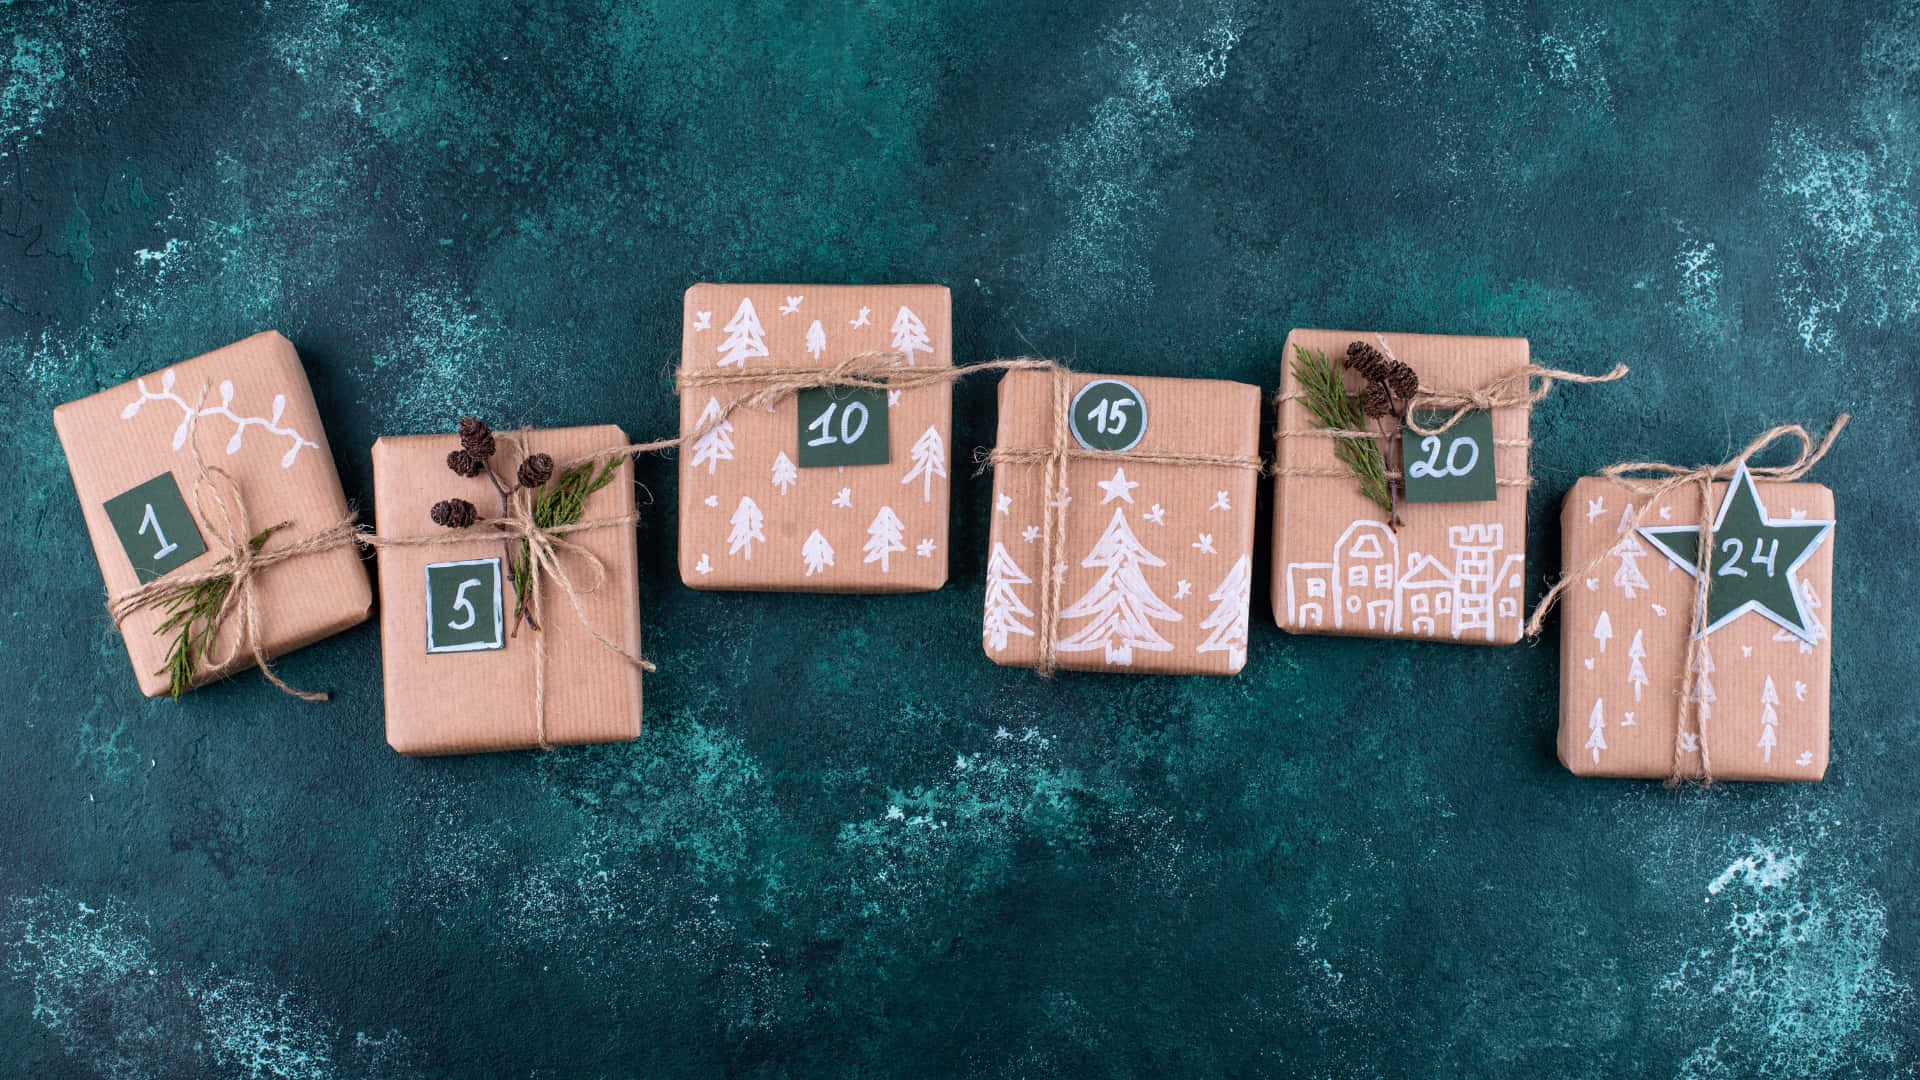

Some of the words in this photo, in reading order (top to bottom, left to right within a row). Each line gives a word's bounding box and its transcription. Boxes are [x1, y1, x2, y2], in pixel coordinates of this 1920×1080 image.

[807, 401, 869, 447] 10
[1087, 397, 1134, 435] 15
[1409, 433, 1480, 479] 20
[137, 503, 178, 560] 1
[1718, 537, 1780, 578] 24
[447, 578, 482, 631] 5
